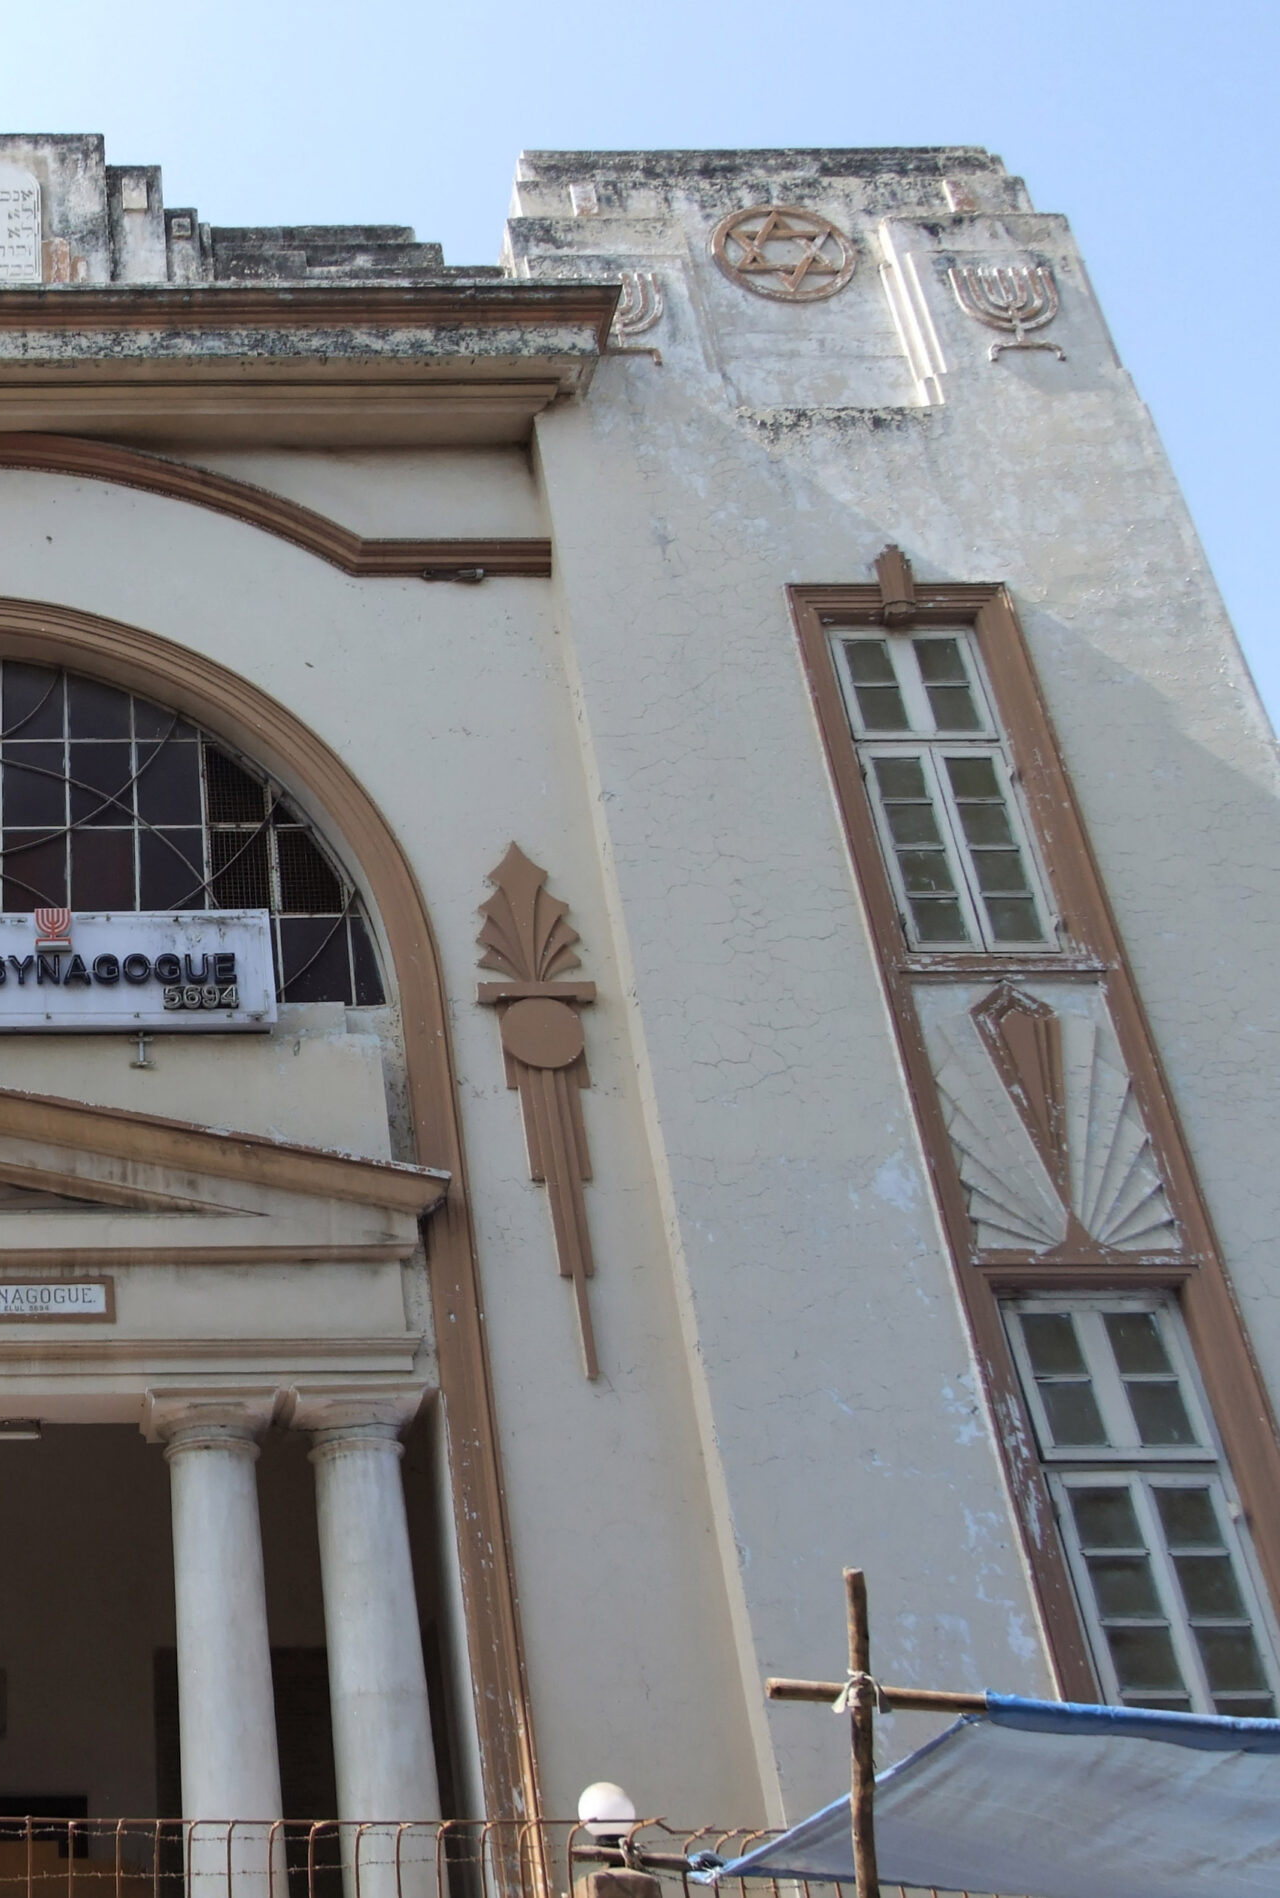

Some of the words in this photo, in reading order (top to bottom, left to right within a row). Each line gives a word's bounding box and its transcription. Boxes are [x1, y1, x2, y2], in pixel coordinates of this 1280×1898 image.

[8, 203, 34, 220] לא
[7, 222, 34, 239] לא
[163, 984, 240, 1010] 5694
